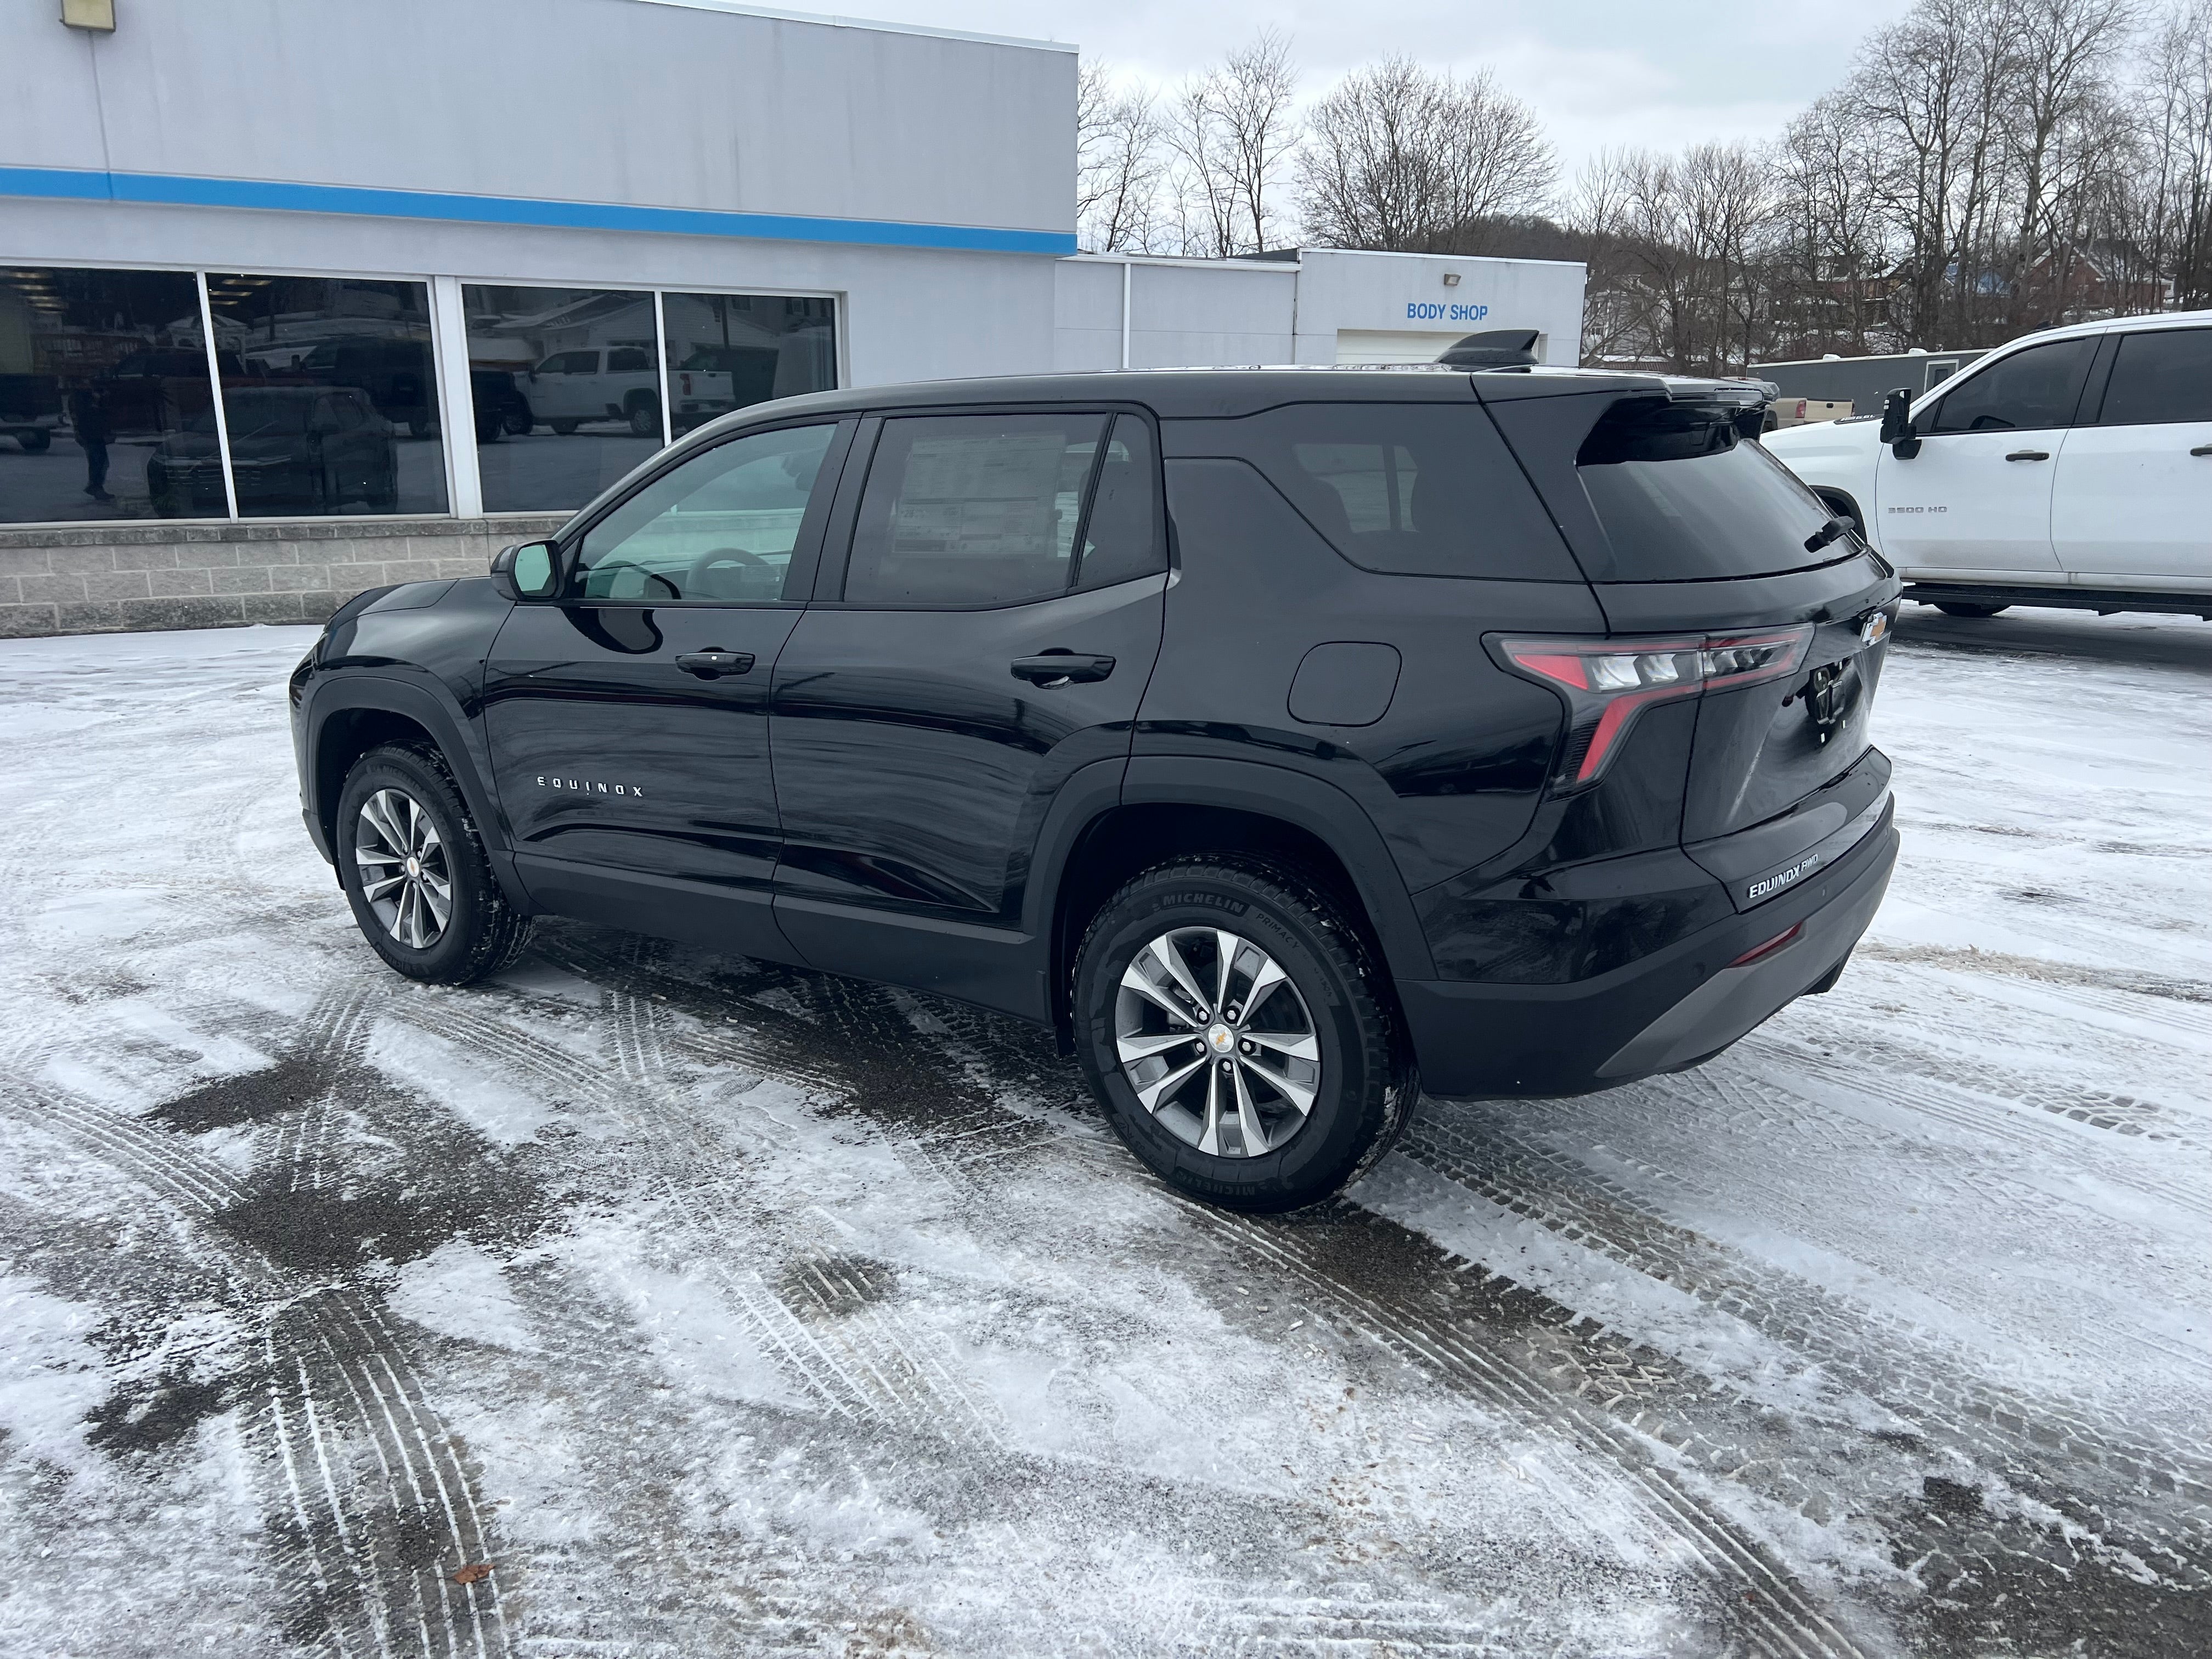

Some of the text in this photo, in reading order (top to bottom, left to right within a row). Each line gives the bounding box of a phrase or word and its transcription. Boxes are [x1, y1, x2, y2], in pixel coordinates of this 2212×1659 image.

[1407, 303, 1487, 320] BODY SHOP
[537, 776, 643, 797] EQUINOX
[1748, 854, 1819, 899] EQUINOX AWD
[1163, 893, 1300, 949] MICHELIN PRIMACY
